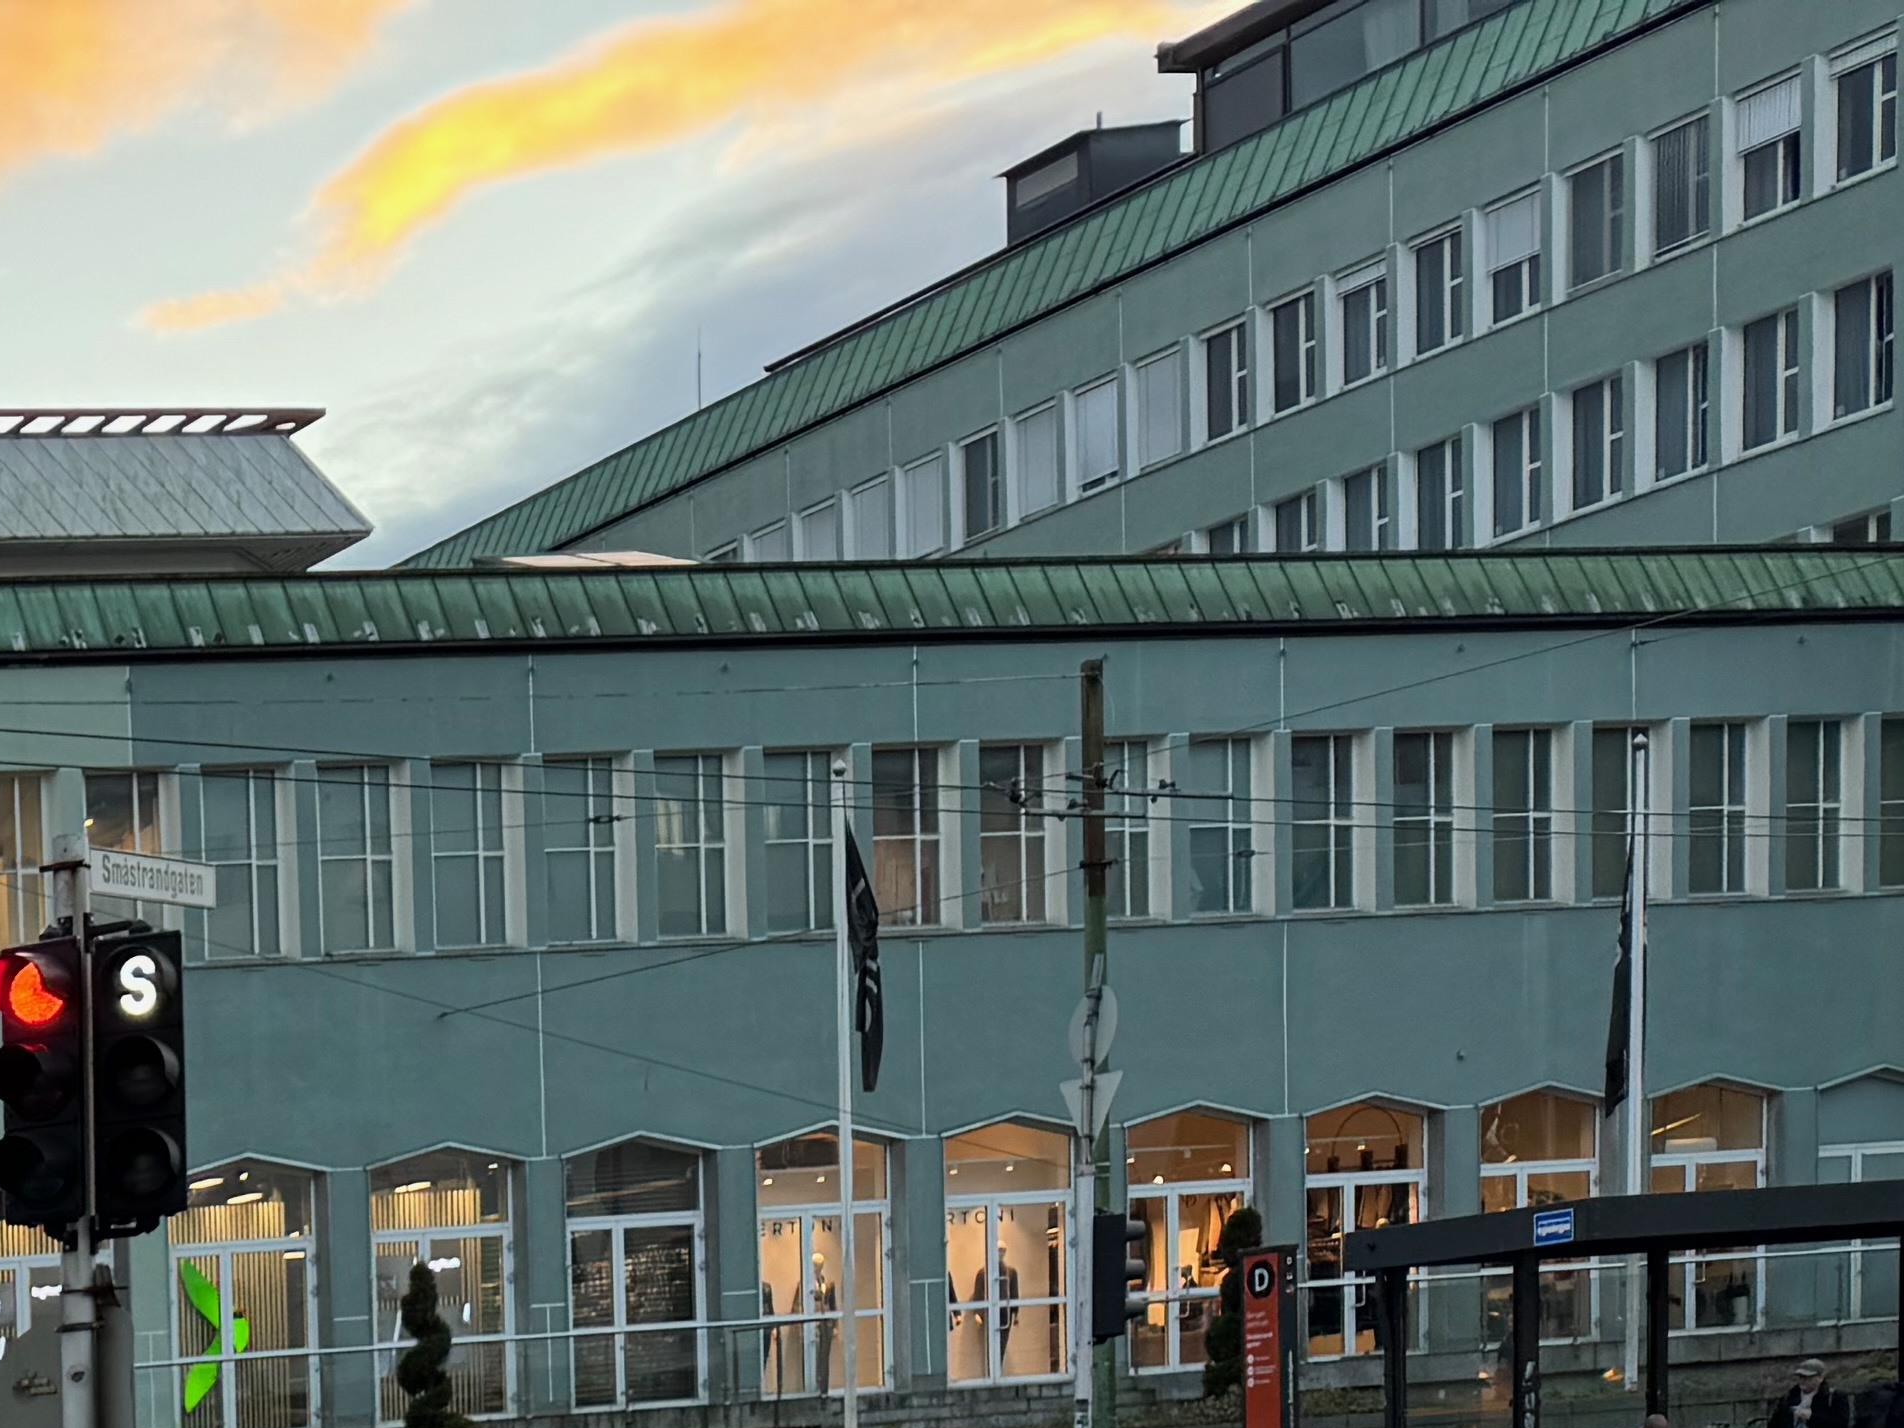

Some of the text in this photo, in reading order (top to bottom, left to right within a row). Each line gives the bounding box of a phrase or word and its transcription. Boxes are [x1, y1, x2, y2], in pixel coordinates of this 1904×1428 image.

[101, 853, 204, 899] Småstrandgaten
[118, 952, 159, 1017] S
[1254, 1267, 1270, 1292] D
